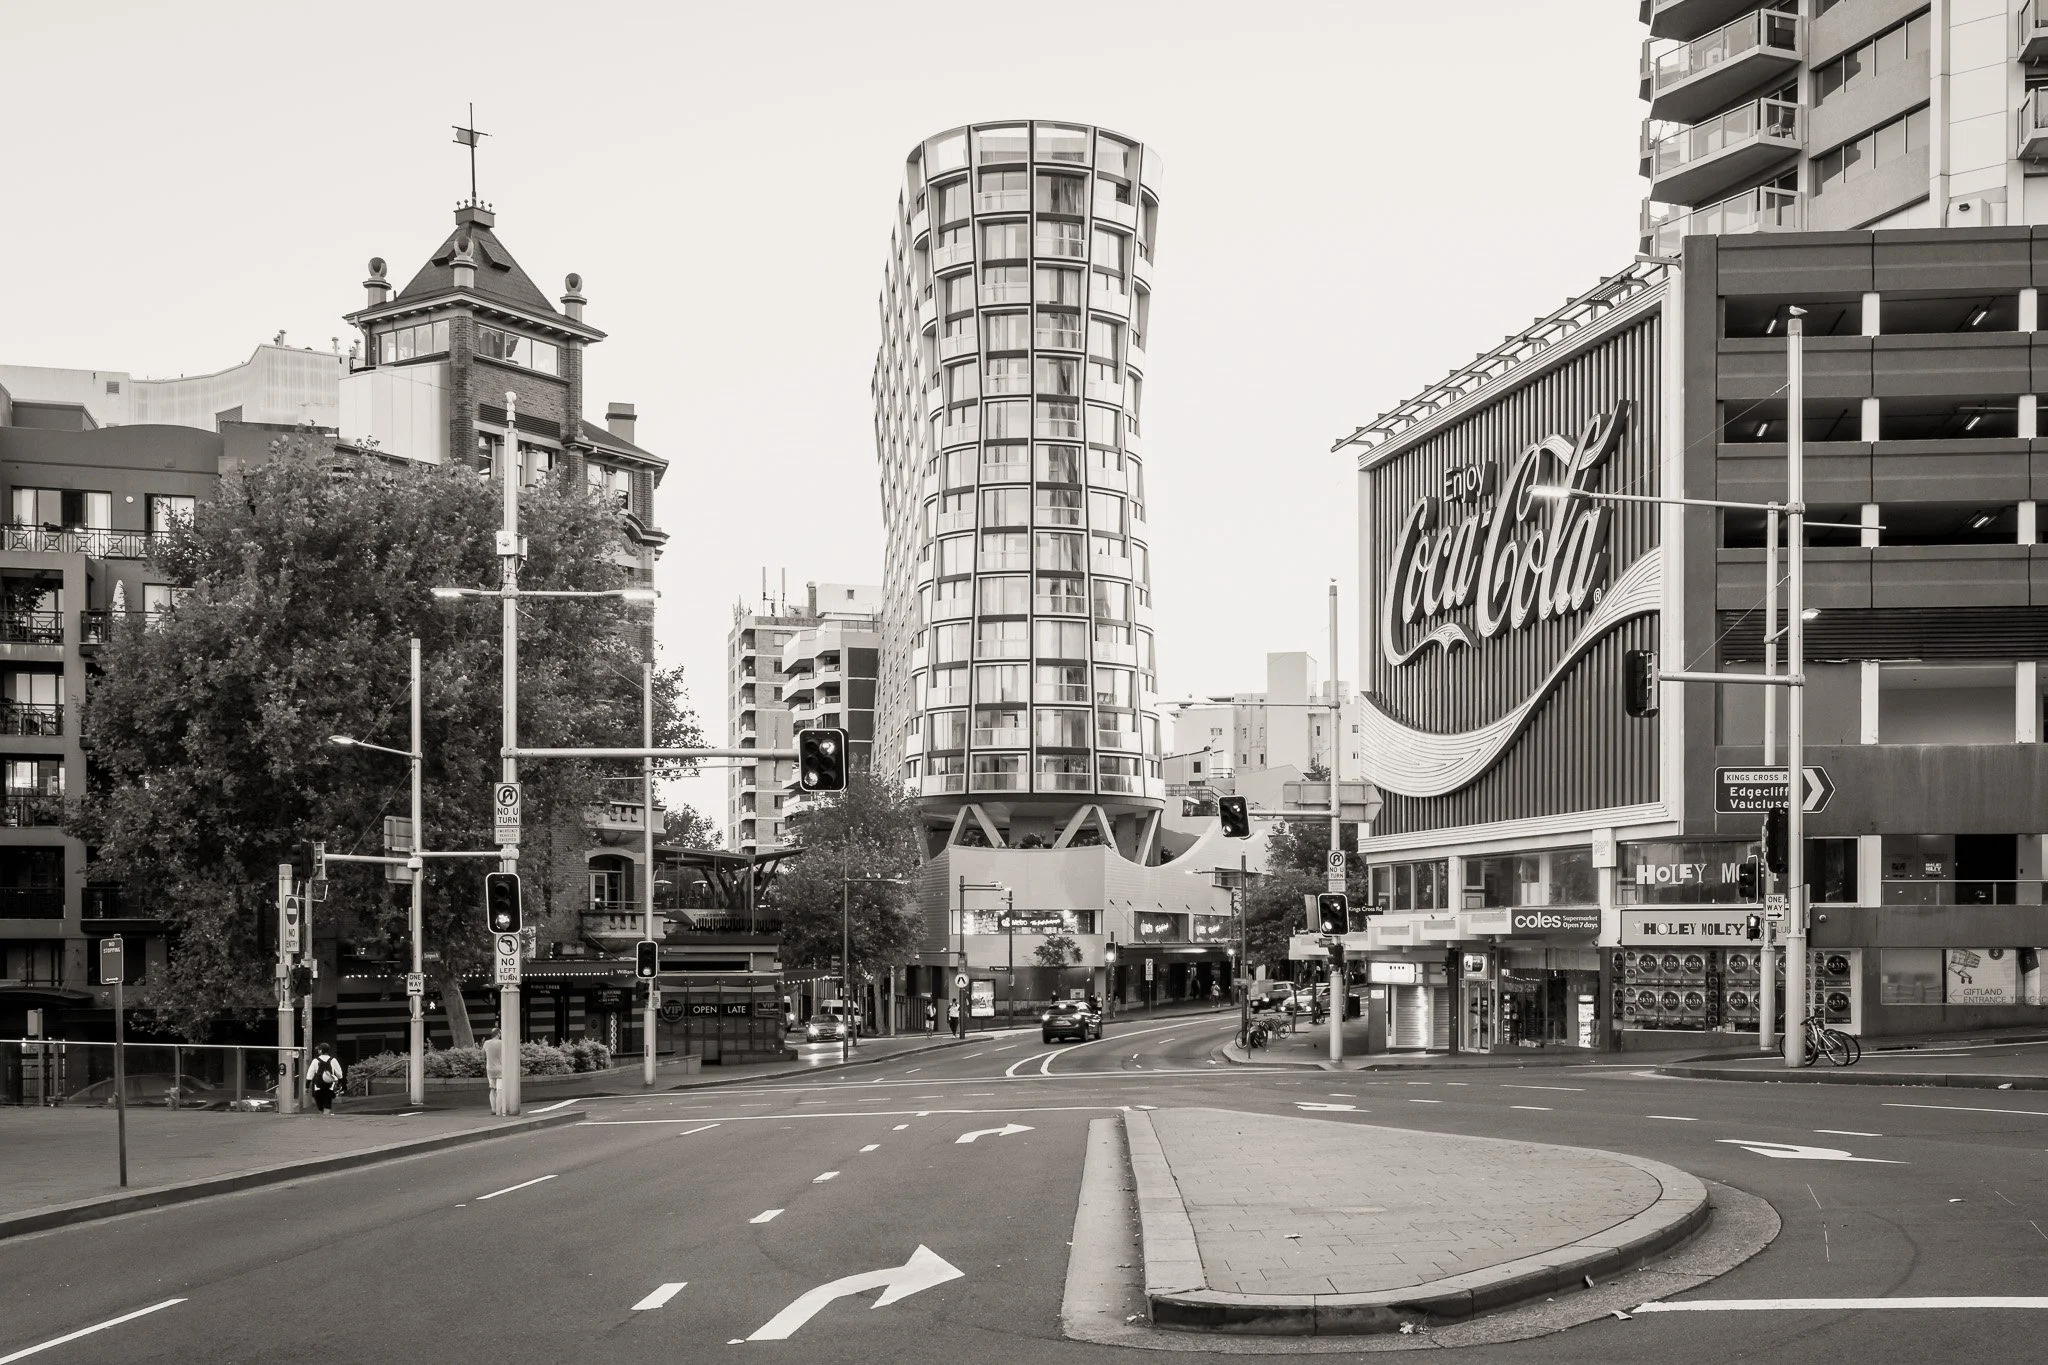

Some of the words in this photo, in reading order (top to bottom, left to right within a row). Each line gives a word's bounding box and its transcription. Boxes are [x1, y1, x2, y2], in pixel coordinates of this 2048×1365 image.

[1444, 460, 1495, 502] Enjoy
[1729, 786, 1789, 799] Edgecliff
[1729, 799, 1789, 809] Vaucluse
[497, 807, 509, 815] NO
[513, 807, 519, 815] U
[498, 816, 518, 824] TURN
[1636, 863, 1707, 885] HOLEY
[1514, 911, 1562, 929] coles
[1562, 922, 1579, 930] Open
[1583, 922, 1598, 930] days
[1643, 922, 1697, 935] HOLEY
[1701, 923, 1745, 936] MOLEY
[288, 928, 296, 938] NO
[286, 940, 298, 948] ENTRY
[501, 958, 515, 966] NO
[1963, 988, 2003, 996] GIFTLAND
[1963, 996, 2006, 1004] ENTRANCE
[663, 1006, 682, 1015] VIP
[692, 1005, 718, 1014] OPEN
[727, 1005, 746, 1014] LATE
